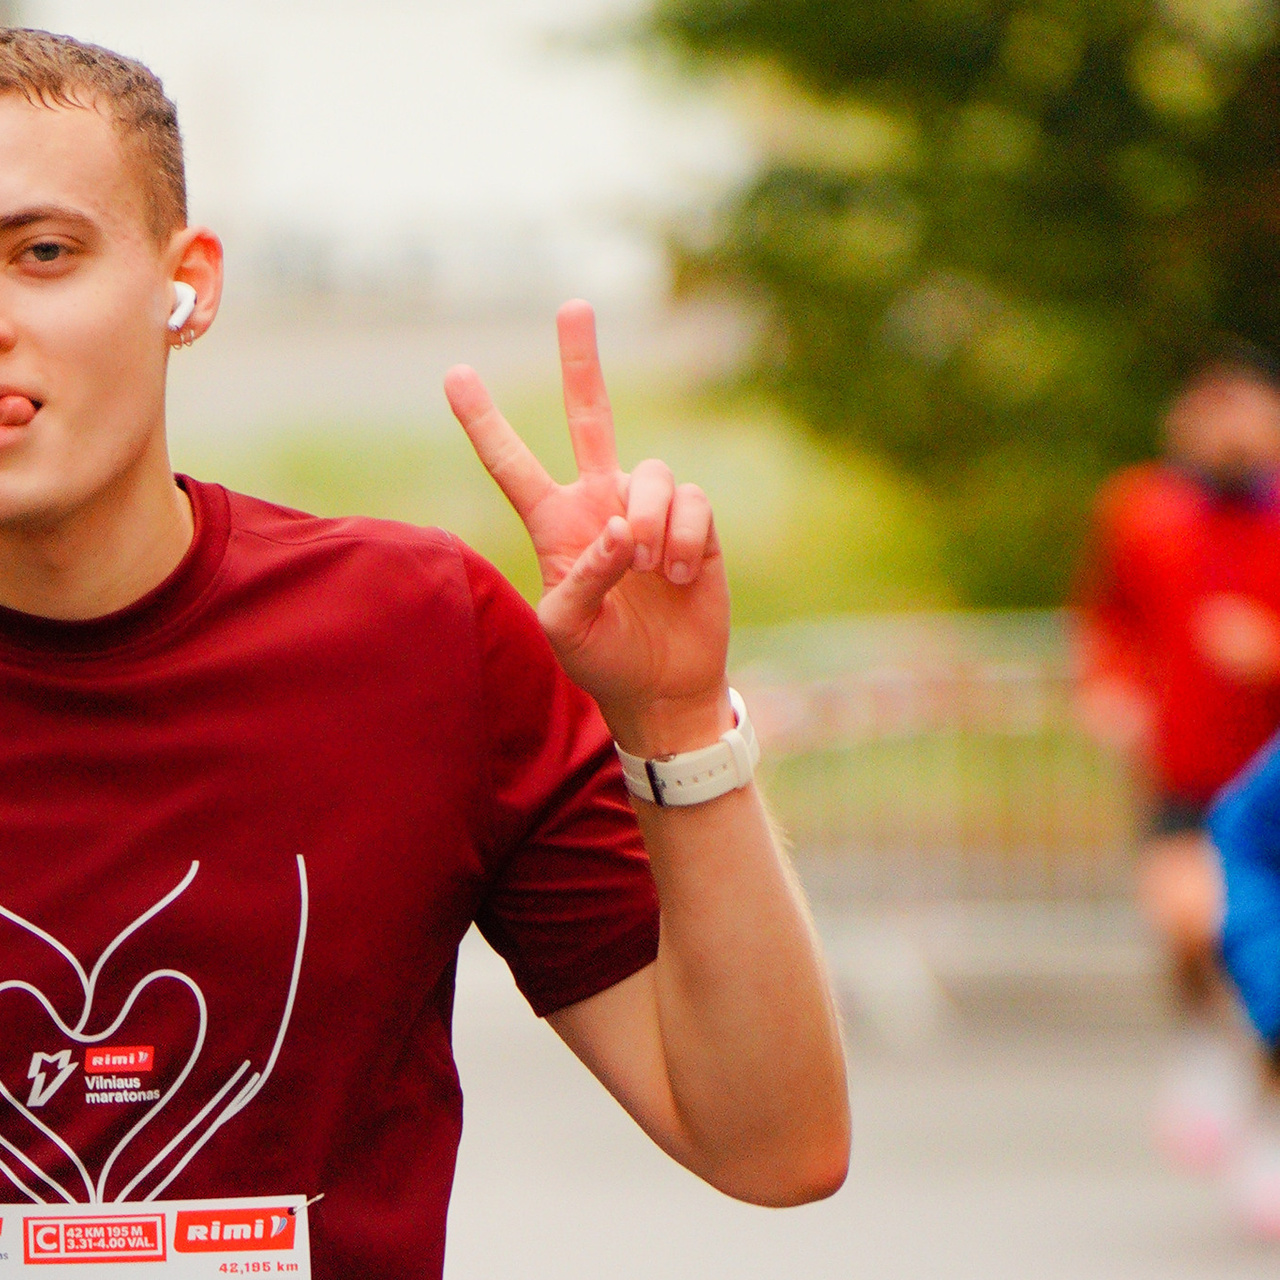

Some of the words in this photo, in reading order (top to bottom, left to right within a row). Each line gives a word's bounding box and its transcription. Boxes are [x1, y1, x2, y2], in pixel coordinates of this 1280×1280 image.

[84, 1075, 141, 1090] Vilniaus
[85, 1089, 160, 1104] maratonas
[36, 1226, 58, 1251] C
[66, 1227, 83, 1238] 42
[85, 1227, 105, 1238] KM
[107, 1226, 129, 1237] 195
[131, 1225, 143, 1237] M
[66, 1238, 126, 1250] 3.31-4.00
[127, 1237, 155, 1248] VAL.
[219, 1261, 271, 1274] 42,195
[277, 1261, 298, 1272] km
